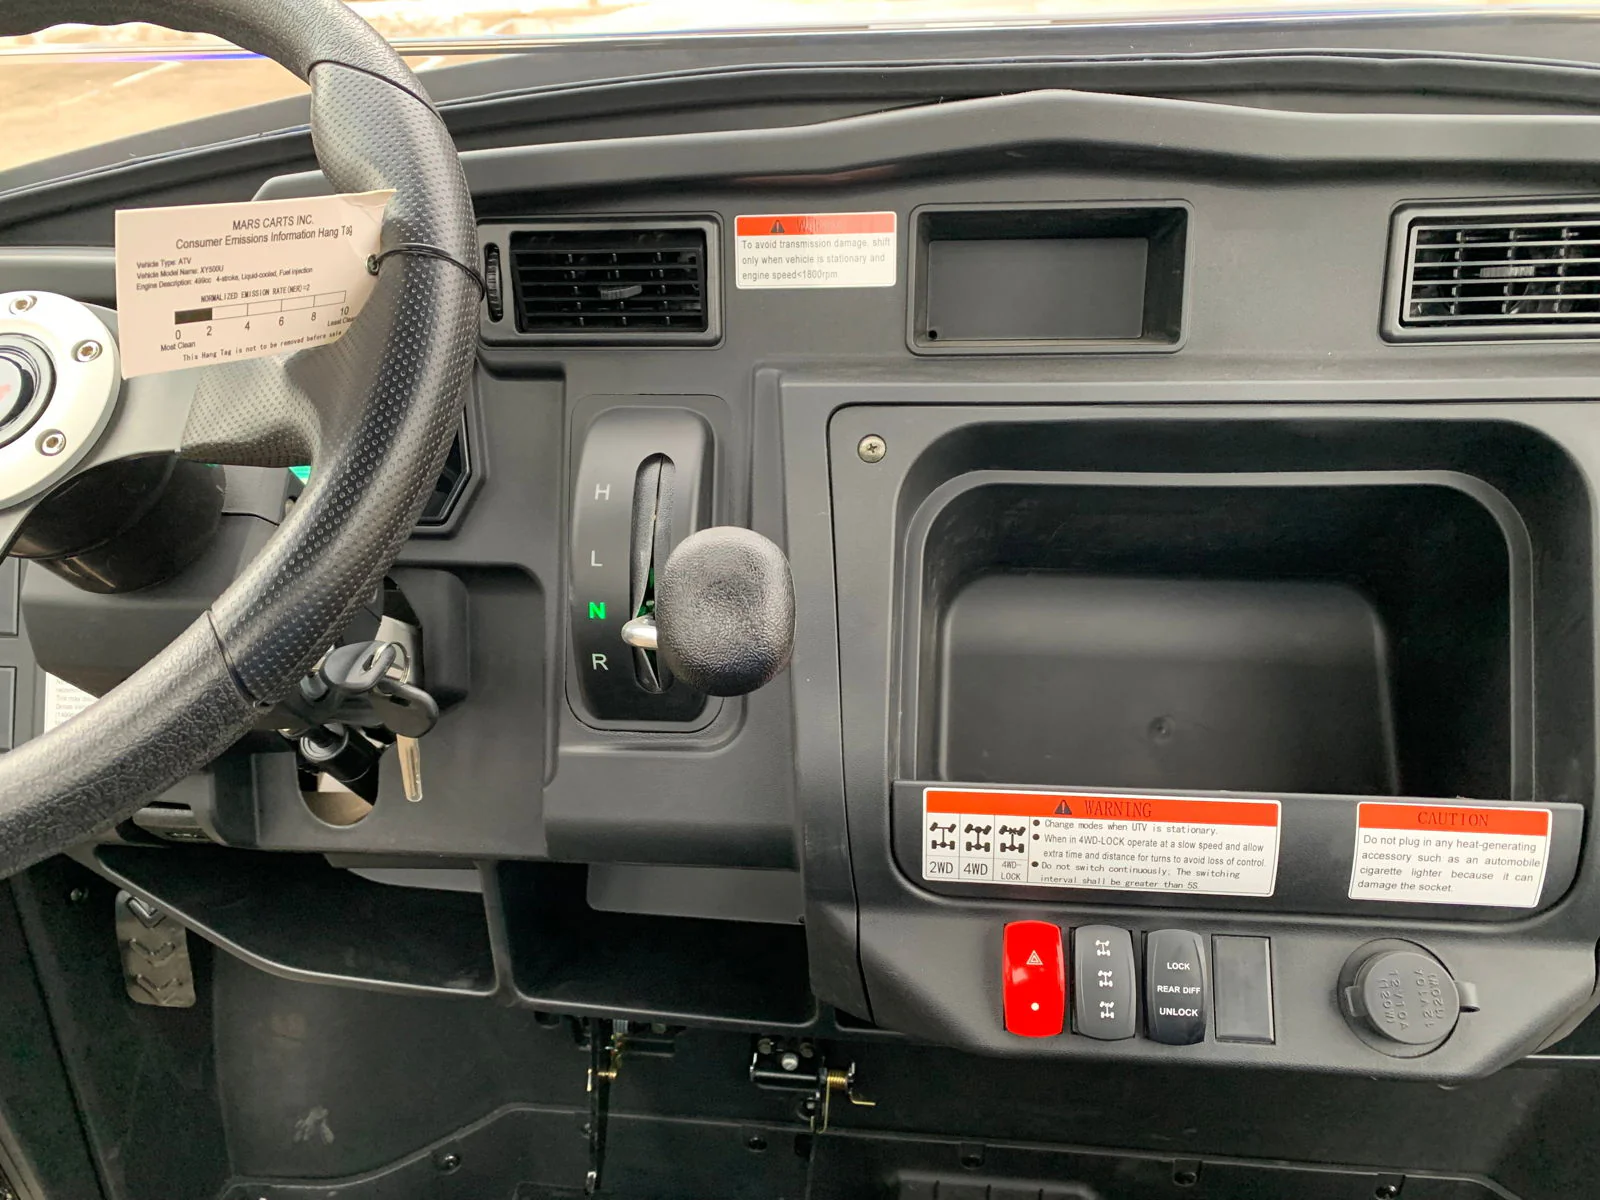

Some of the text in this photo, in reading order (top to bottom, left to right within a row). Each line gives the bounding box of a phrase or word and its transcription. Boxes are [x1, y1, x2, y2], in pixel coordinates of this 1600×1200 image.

[232, 214, 314, 230] MARS CARTS INC.
[175, 225, 353, 250] Consumer Emissions Information Hang Tag
[742, 240, 752, 249] To
[755, 239, 777, 249] avoid
[779, 238, 832, 249] transmission
[872, 236, 891, 247] shift
[136, 260, 159, 269] Vehicle
[178, 257, 192, 265] ATV
[742, 253, 886, 266] only when vehicle is stationary and
[136, 271, 159, 279] Vehicle
[160, 269, 179, 277] Model
[200, 265, 224, 274] XY500U
[136, 282, 158, 291] Engine
[291, 267, 313, 276] injection
[742, 270, 770, 282] engine
[200, 292, 238, 303] NORMALIZED
[241, 288, 269, 298] EMISSION
[175, 305, 350, 340] 0 2 4 6 8 10
[160, 341, 196, 352] Most Clean
[183, 353, 198, 361] This
[201, 351, 217, 360] Hang
[220, 348, 232, 356] Tag
[245, 345, 257, 353] not
[280, 337, 304, 346] removed
[306, 333, 326, 342] before
[329, 330, 342, 338] sale
[595, 483, 611, 500] H
[590, 550, 603, 567] L
[588, 602, 606, 619] N
[591, 653, 609, 671] R
[1084, 799, 1152, 818] WARNING
[1417, 811, 1489, 827] CAUTION
[1045, 819, 1218, 836] Change modes when UTV is stationary.
[1044, 833, 1068, 843] When
[1069, 834, 1077, 843] in
[1079, 835, 1125, 846] 4WD-LOCK
[1127, 837, 1157, 849] operate
[1160, 839, 1168, 847] at
[1177, 840, 1196, 849] slow
[1198, 840, 1223, 851] speed
[1225, 841, 1241, 851] and
[1243, 842, 1264, 852] allow
[1363, 834, 1537, 853] Do not plug in any heat-generating
[1043, 849, 1064, 858] extra
[1065, 850, 1083, 859] time
[1084, 851, 1099, 860] and
[1102, 851, 1136, 862] distance
[1138, 852, 1148, 861] for
[1151, 853, 1171, 863] turns
[1173, 854, 1182, 864] to
[1183, 855, 1205, 865] avoid
[1207, 856, 1224, 865] loss
[1226, 857, 1235, 866] of
[1361, 852, 1541, 868] accessory such as an automobile
[929, 861, 954, 875] 2WD
[963, 863, 988, 876] 4WD
[1041, 861, 1052, 870] Do
[1055, 862, 1071, 871] not
[1076, 863, 1105, 872] switch
[1177, 867, 1192, 876] The
[1196, 868, 1241, 880] switching
[1359, 866, 1534, 882] cigarette lighter because it can
[1000, 872, 1021, 881] LOCK
[1040, 875, 1198, 889] interval shall be greater than 5S
[1358, 880, 1453, 892] damage the socket.
[1167, 962, 1190, 971] LOCK
[1157, 985, 1181, 993] REAR
[1159, 1007, 1199, 1016] UNLOCK
